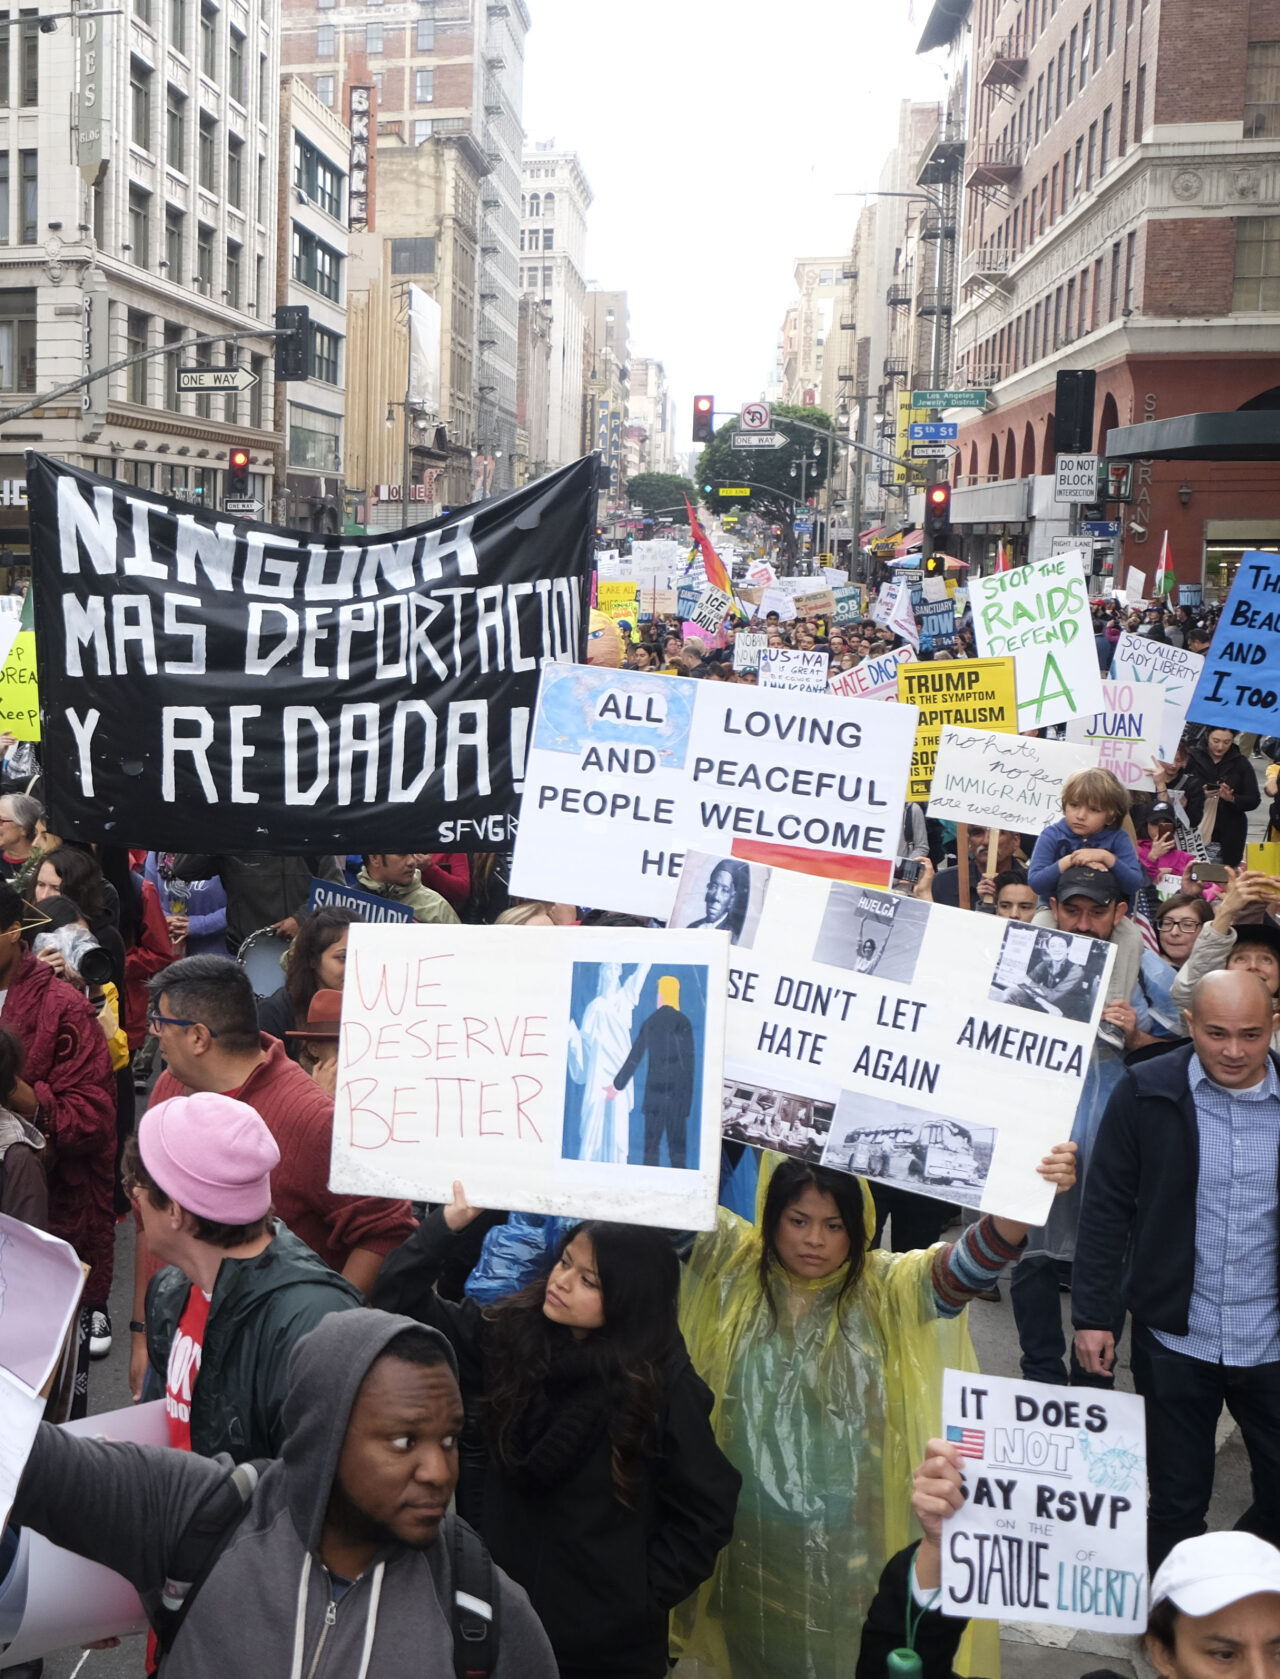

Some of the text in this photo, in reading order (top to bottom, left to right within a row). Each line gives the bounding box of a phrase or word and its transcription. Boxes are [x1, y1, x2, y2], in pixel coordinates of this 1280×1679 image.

[79, 129, 100, 144] BLDG
[182, 374, 237, 387] ONE WAY
[917, 399, 947, 407] Jewelry
[951, 398, 980, 406] District
[944, 392, 975, 400] Angeles
[736, 437, 775, 445] ONE WAY
[913, 426, 954, 437] 5th St
[1060, 460, 1095, 471] DO NOT
[1056, 489, 1094, 497] INTERSECTION
[1059, 475, 1094, 486] BLOCK
[56, 475, 479, 600] NINGUNA
[982, 561, 1066, 600] STOP THE
[705, 593, 726, 612] ICE
[915, 601, 953, 615] SANCTUARY
[981, 577, 1084, 635] RAIDS
[63, 593, 207, 677] MAS
[691, 611, 718, 634] JAILS
[986, 619, 1079, 657] DEFEND
[1122, 634, 1188, 664] SO-CALLED
[1120, 649, 1200, 682] LADY LIBERTY
[1219, 641, 1267, 665] AND
[831, 668, 870, 696] HATE
[904, 671, 980, 694] TRUMP
[906, 691, 996, 705] IS THE SYMPTOM
[1103, 685, 1134, 712] NO
[1235, 685, 1279, 713] TOO,
[598, 694, 863, 749] ALL LOVING
[918, 706, 1005, 726] APITALISM
[1086, 712, 1143, 737] JUAN
[64, 706, 101, 798] Y
[581, 746, 888, 808] AND PEACEFUL
[945, 774, 1063, 812] IMMIGRANTS
[537, 785, 886, 854] PEOPLE WELCOME
[930, 796, 1036, 826] are welcome
[858, 896, 897, 919] HUELGA
[355, 949, 455, 1016] WE
[343, 1015, 548, 1069] DESERVE
[774, 976, 1085, 1079] DON'T LET AMERICA
[756, 1022, 941, 1095] HATE AGAIN
[341, 1074, 544, 1151] BETTER
[960, 1386, 1108, 1433] IT DOES
[994, 1427, 1074, 1472] NOT
[1036, 1484, 1132, 1529] RSVP
[995, 1518, 1054, 1537] ON THE
[948, 1531, 1145, 1621] STATUE OF LIBERTY
